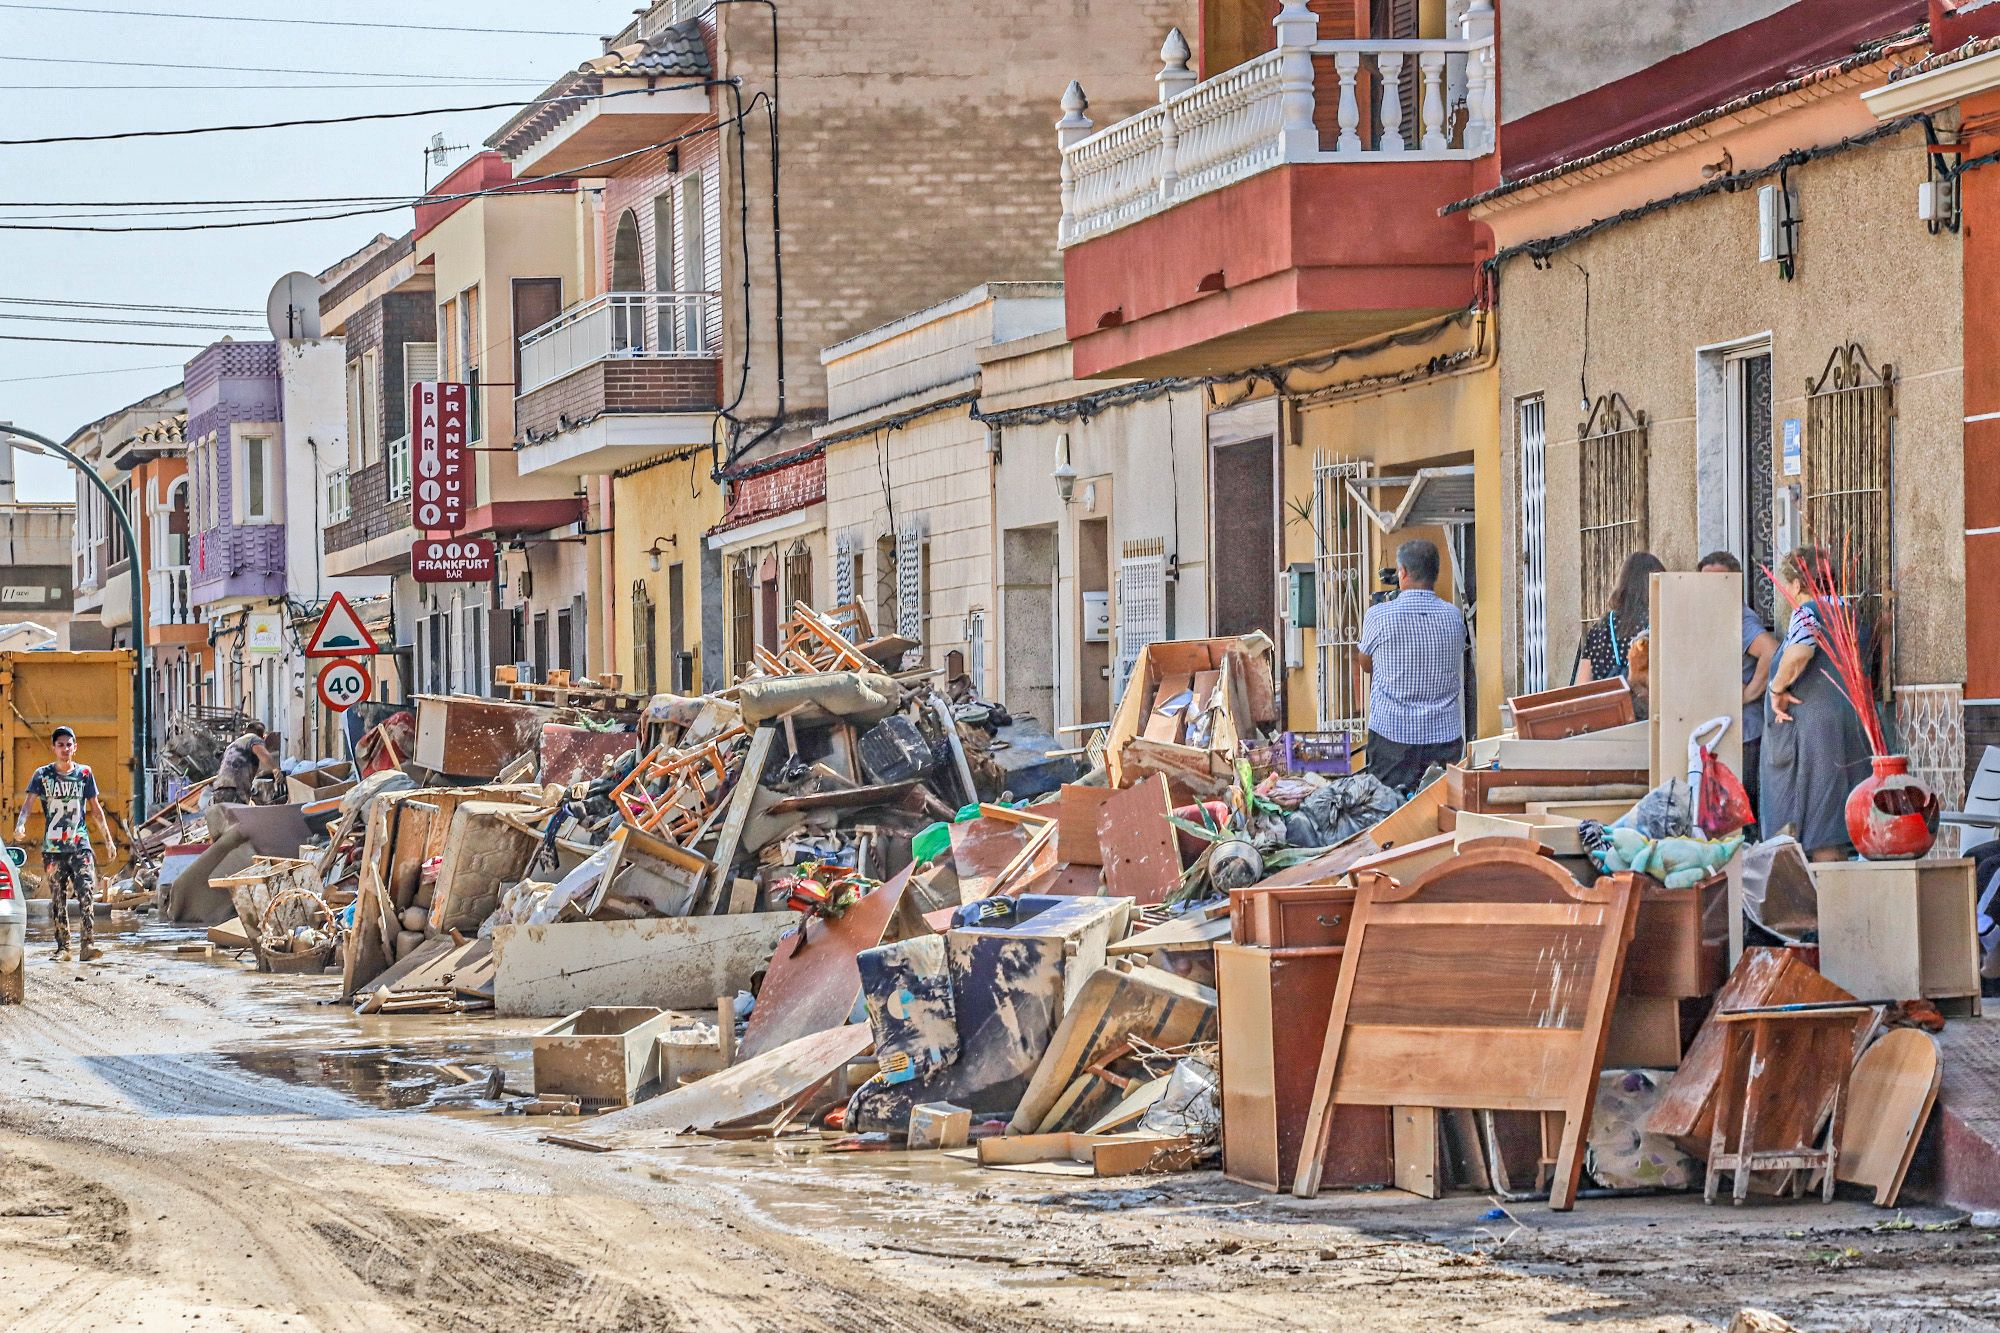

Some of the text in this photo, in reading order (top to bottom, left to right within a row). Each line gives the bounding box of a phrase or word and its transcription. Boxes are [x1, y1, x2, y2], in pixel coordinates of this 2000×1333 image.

[424, 391, 436, 451] BAR
[446, 385, 460, 523] FRANKFURT
[418, 559, 490, 570] FRANKFURT
[446, 570, 463, 579] BAR
[328, 676, 360, 694] 40
